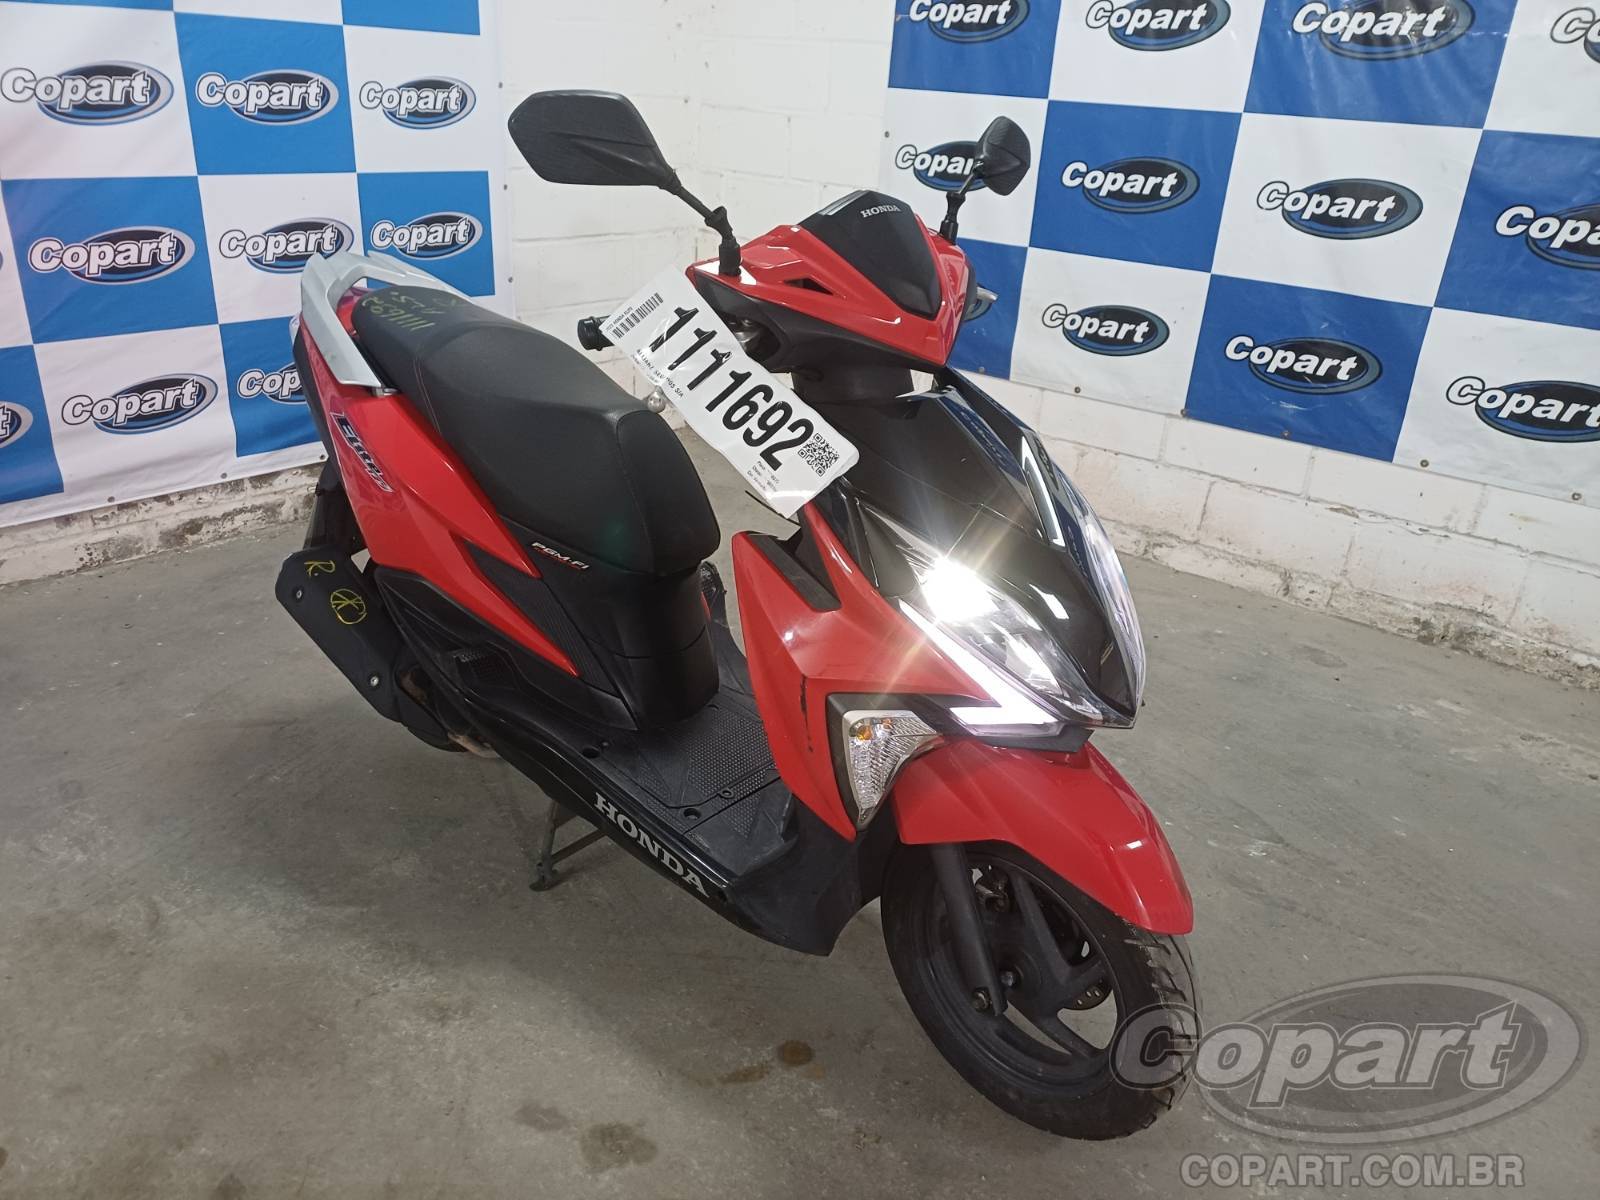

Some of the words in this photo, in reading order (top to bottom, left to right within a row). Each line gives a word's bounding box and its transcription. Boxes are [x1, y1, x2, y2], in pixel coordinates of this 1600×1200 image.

[910, 0, 1011, 28] Copart
[1086, 0, 1208, 35] Copart
[1292, 2, 1446, 42] Copart
[0, 67, 151, 111] Copart
[196, 73, 322, 115] Copart
[360, 81, 461, 117] Copart
[895, 144, 975, 177] Copar
[1061, 161, 1178, 203] Copart
[860, 204, 901, 218] HONDA
[1257, 180, 1397, 227] Copart
[219, 224, 338, 264] Copart
[372, 217, 470, 257] Copart
[1495, 204, 1600, 249] Cop
[29, 232, 176, 277] Copart
[1042, 303, 1150, 345] Copart
[1225, 335, 1359, 383] Copart
[62, 380, 199, 427] Copart
[237, 368, 302, 399] Cop
[648, 306, 815, 472] 1111692
[1446, 375, 1600, 428] Copart
[593, 791, 710, 898] HONDA
